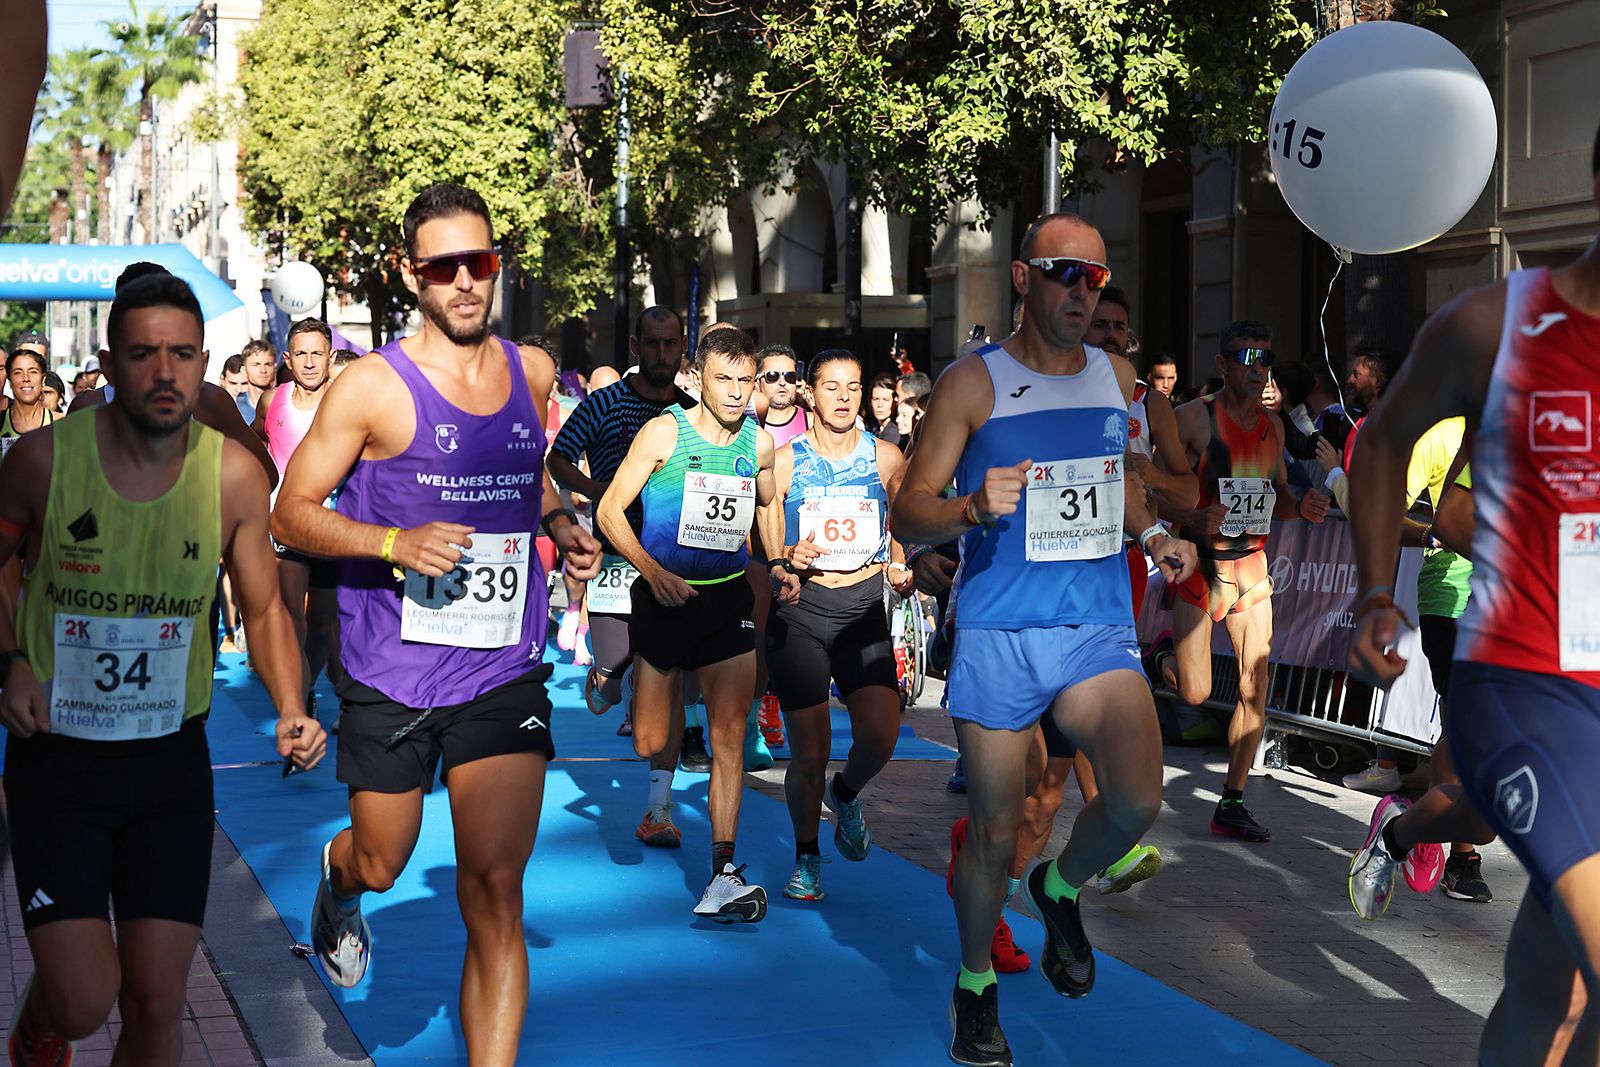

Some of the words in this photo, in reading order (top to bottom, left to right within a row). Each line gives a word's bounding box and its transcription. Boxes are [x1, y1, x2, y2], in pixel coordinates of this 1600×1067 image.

[507, 442, 537, 450] HYROX
[416, 472, 493, 488] WELLNESS
[496, 473, 535, 486] CENTER
[441, 489, 521, 502] BELLAVISTA
[1059, 485, 1098, 522] 31
[1230, 494, 1266, 514] 214
[705, 495, 738, 522] 35
[685, 523, 717, 534] SANCHEZ
[718, 527, 746, 537] RAMIREZ
[824, 518, 857, 542] 63
[1029, 530, 1080, 540] GUTIERREZ
[1082, 524, 1118, 537] GONZALEZ
[58, 560, 101, 575] valora
[598, 567, 636, 588] 285
[1297, 562, 1359, 593] HYUND
[419, 565, 518, 603] 1339
[45, 581, 118, 612] AMIGOS
[407, 609, 469, 620] LECUMBERRI
[94, 652, 152, 693] 34
[55, 698, 118, 714] ZAMBRANO
[120, 698, 177, 713] CUADRADO
